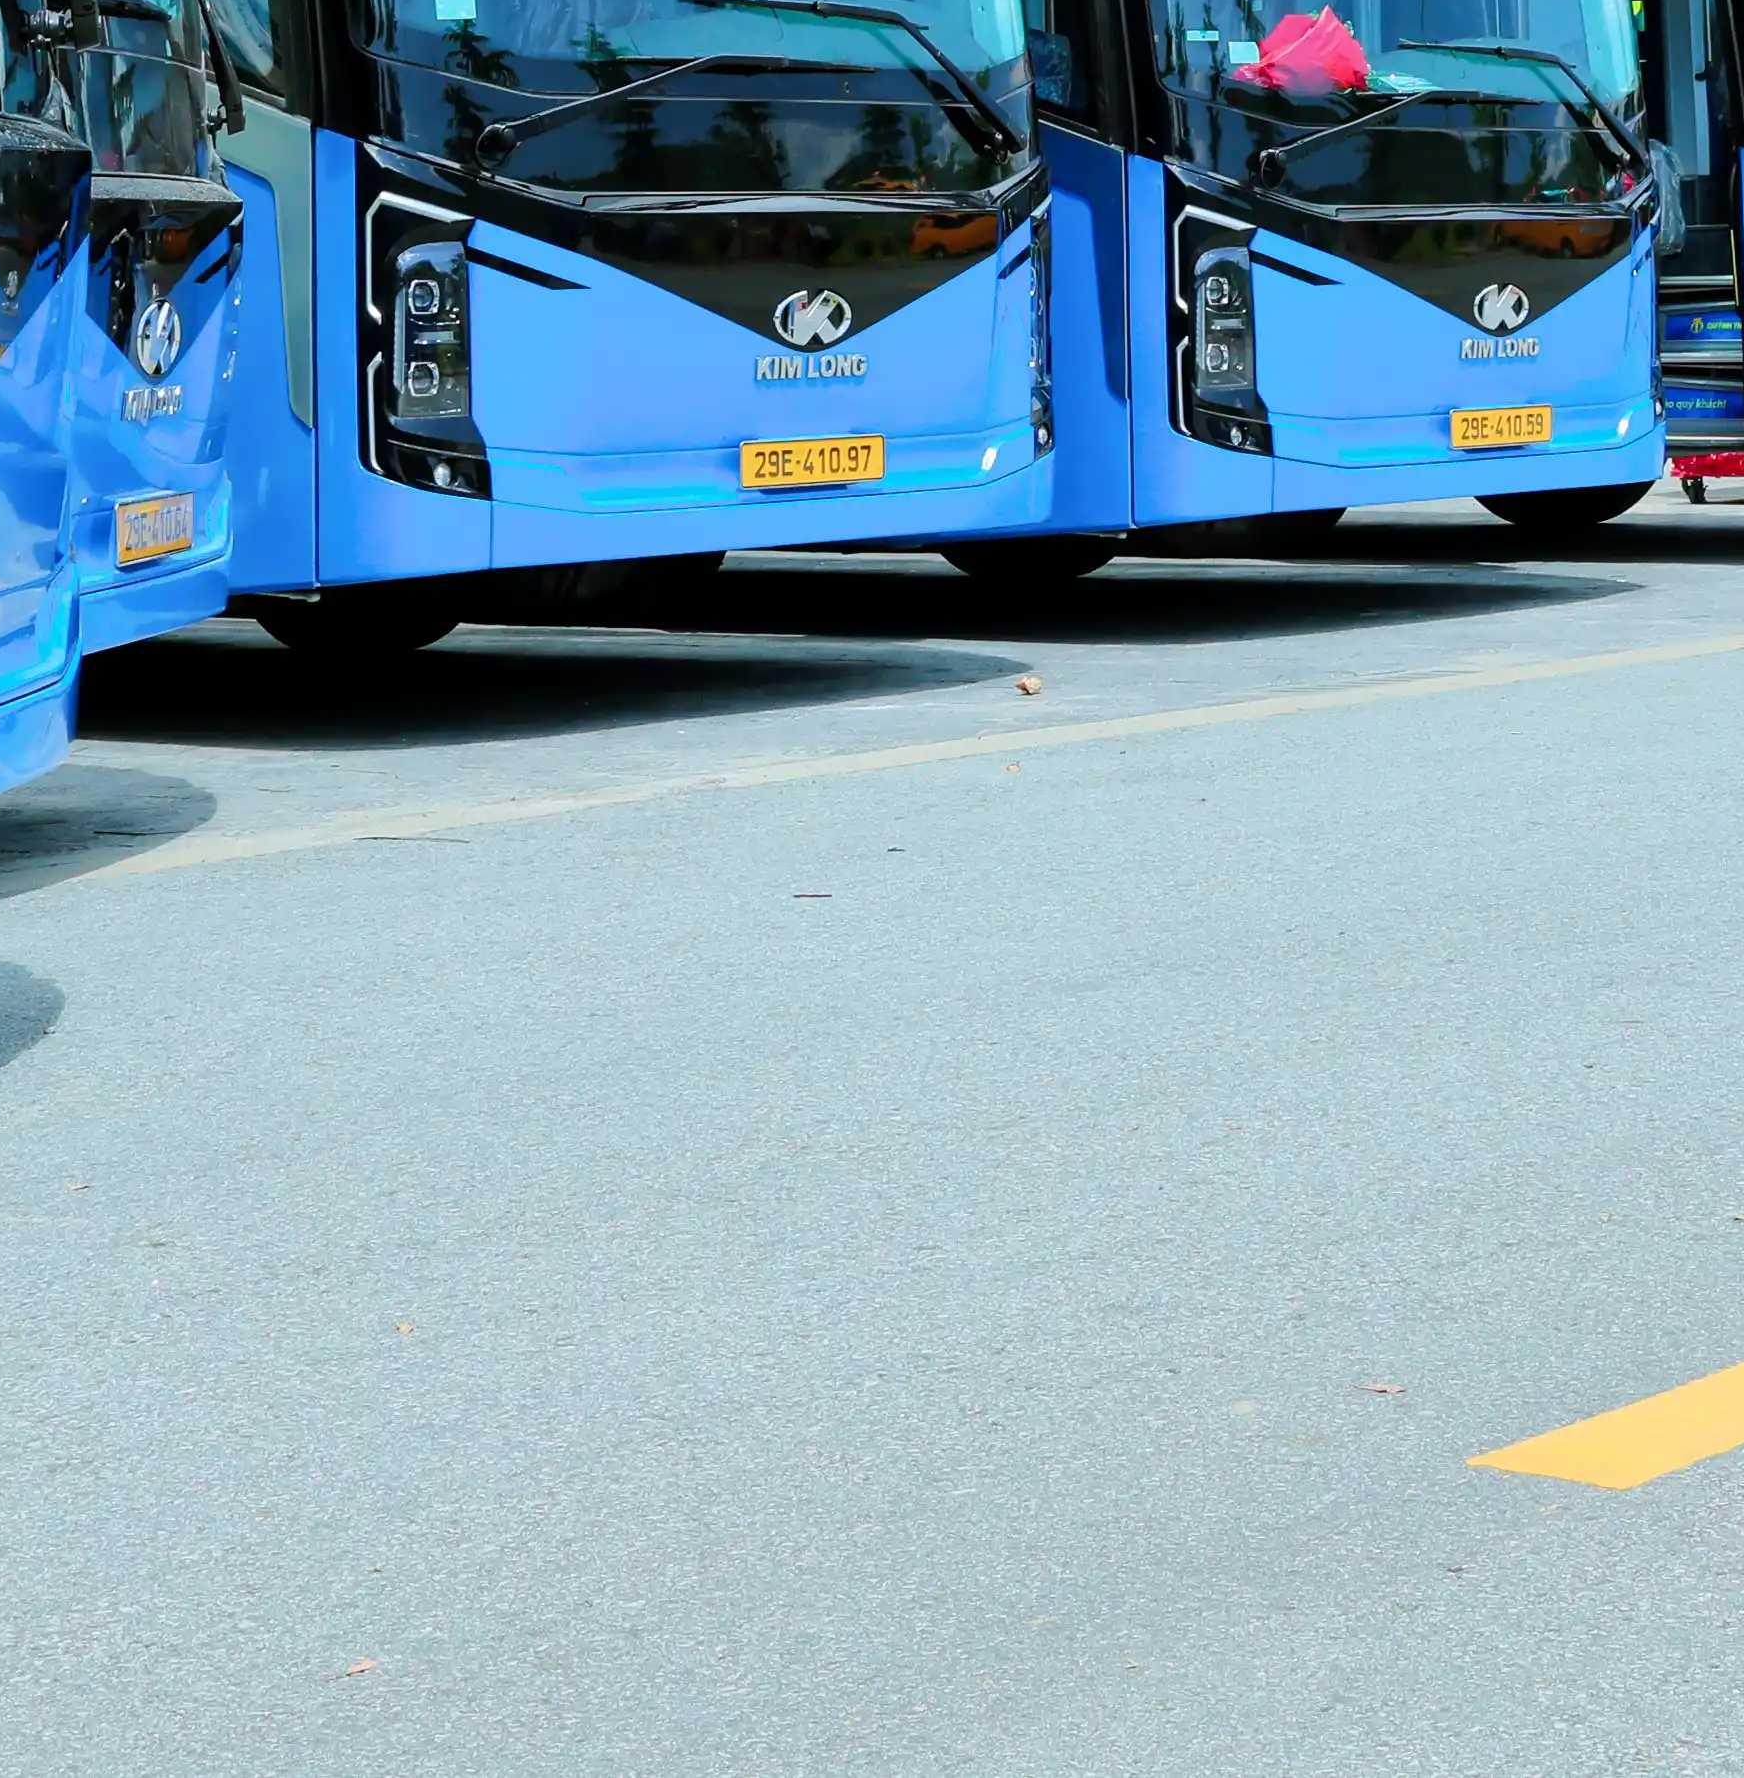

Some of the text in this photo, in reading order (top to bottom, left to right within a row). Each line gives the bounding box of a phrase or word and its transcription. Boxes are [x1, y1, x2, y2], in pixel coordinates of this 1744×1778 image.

[1460, 337, 1540, 359] KIM LONG
[756, 353, 868, 381] KIM LONG
[1460, 412, 1544, 441] 29E-410.59
[754, 444, 872, 479] 29E-410.97
